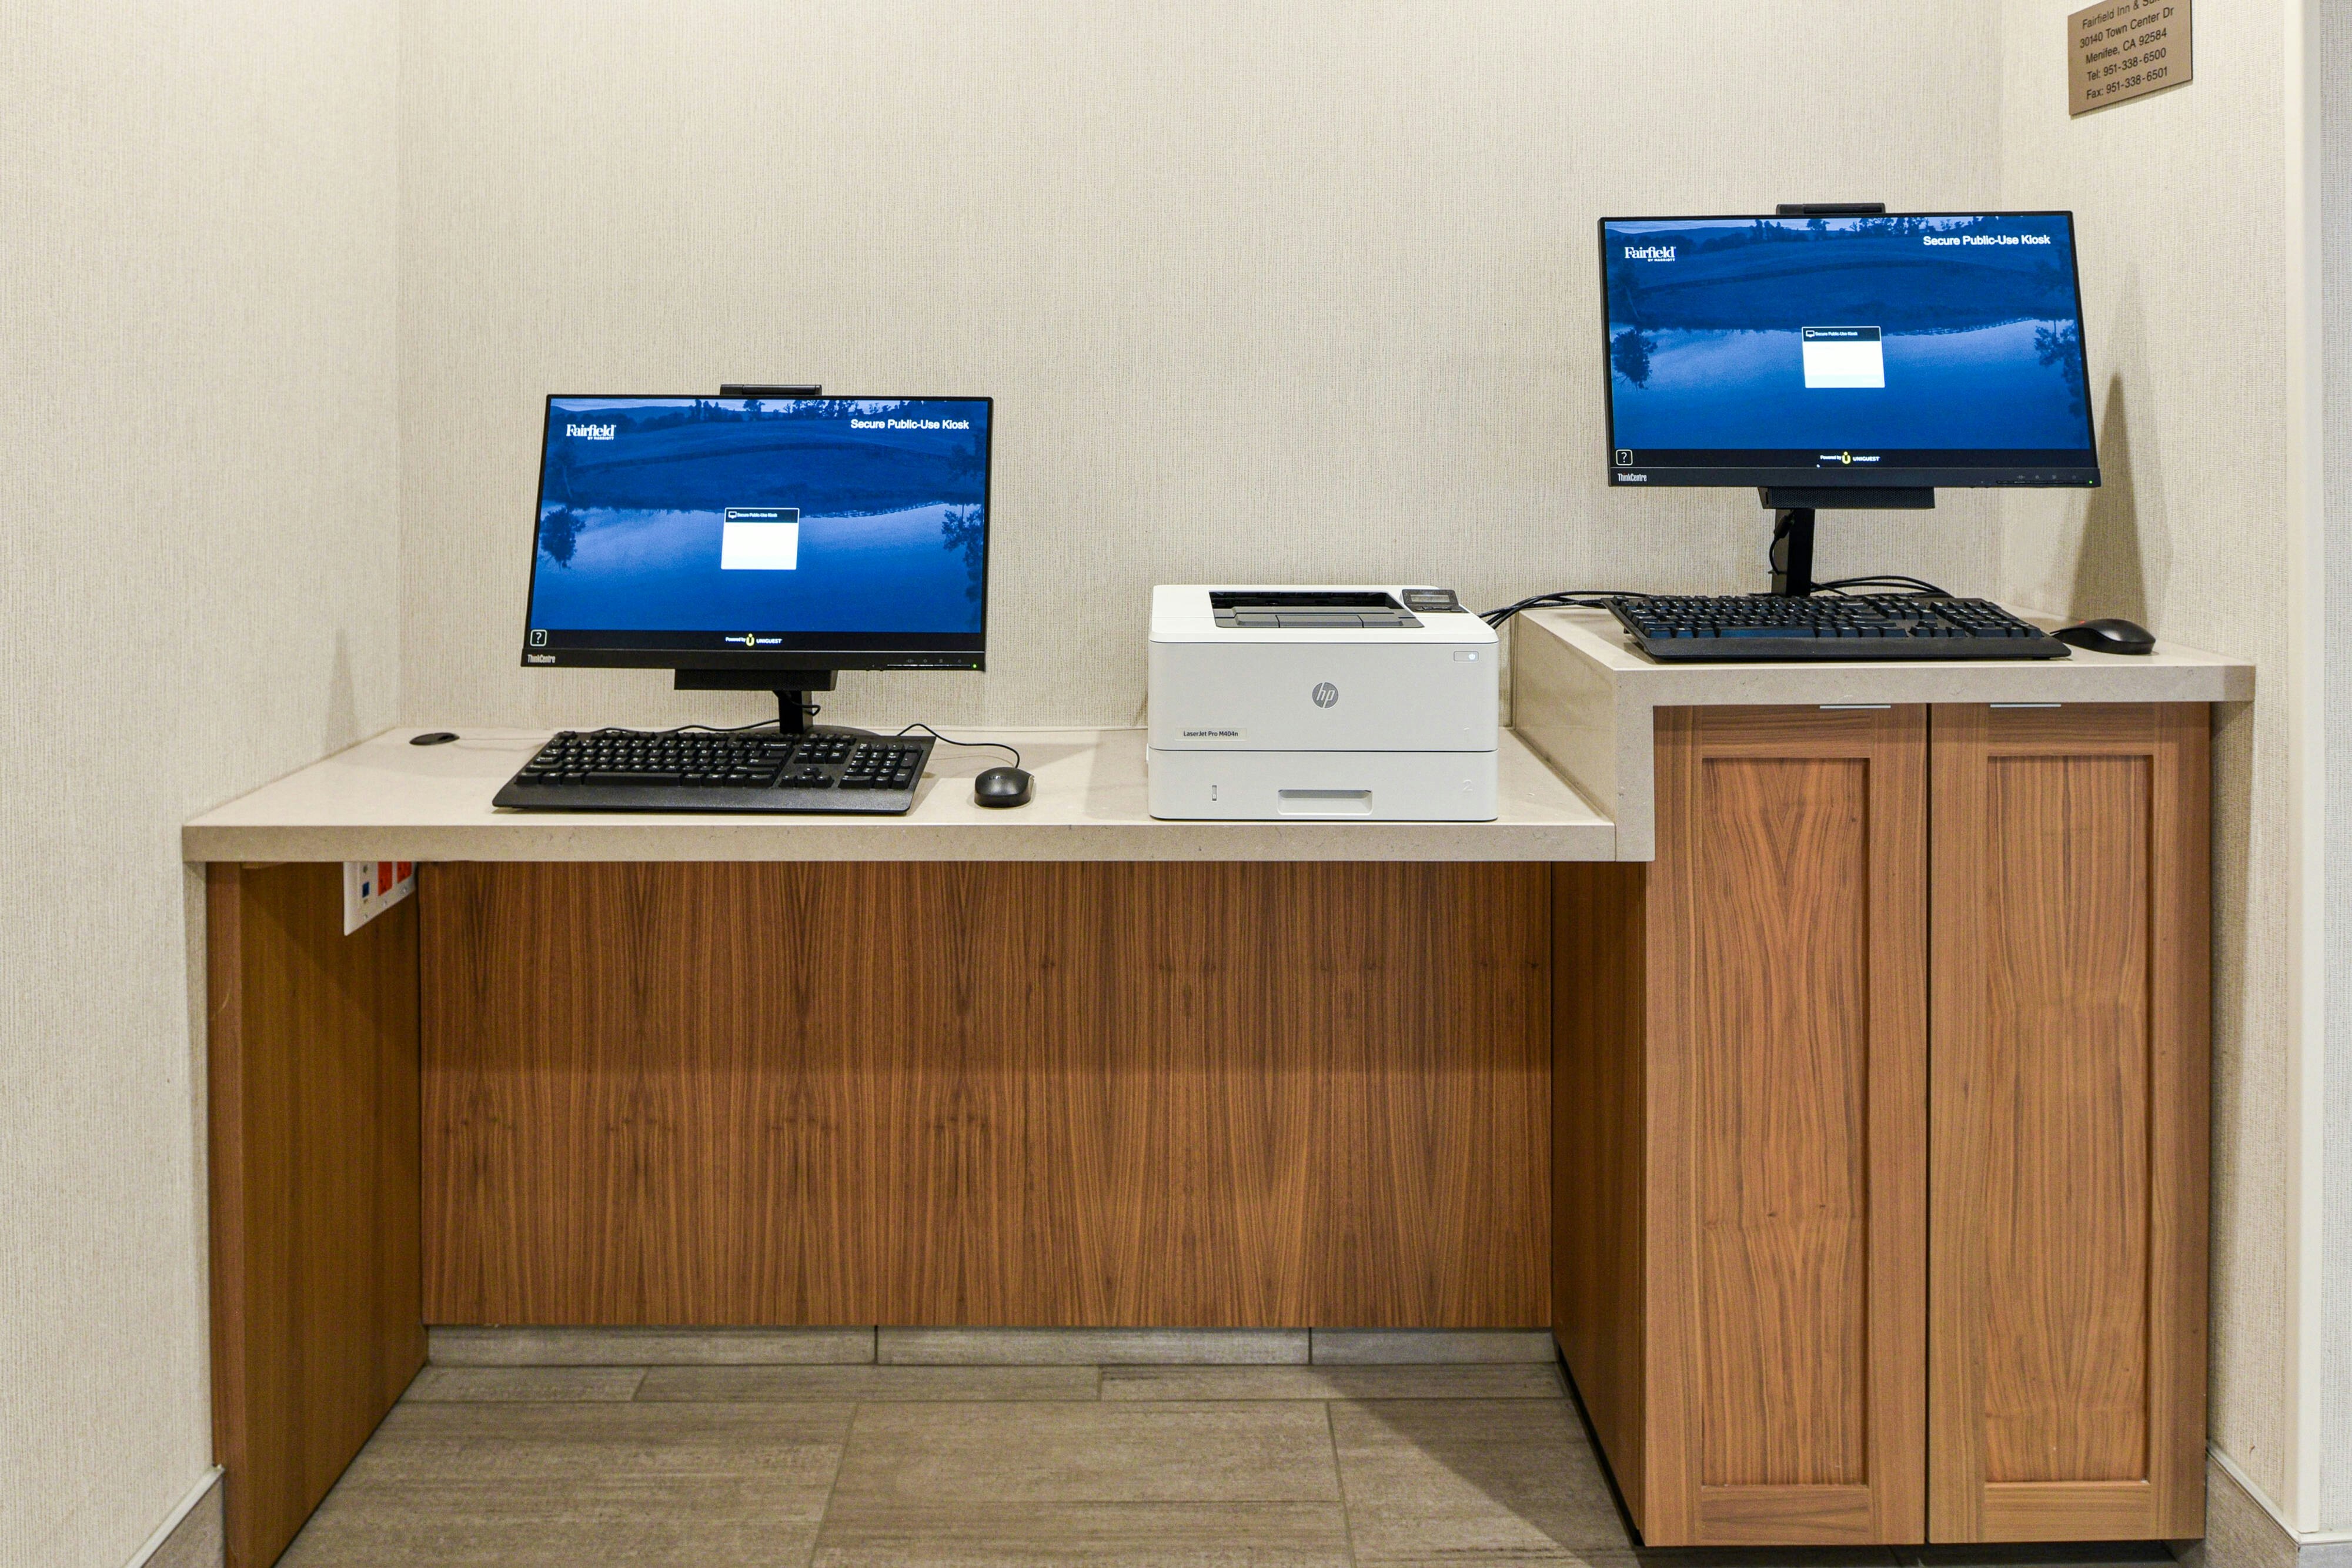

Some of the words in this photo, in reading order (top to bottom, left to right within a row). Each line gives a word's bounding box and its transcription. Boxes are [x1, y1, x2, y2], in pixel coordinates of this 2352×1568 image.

[2082, 8, 2114, 29] Fairfield
[2117, 5, 2130, 16] Inn
[2133, 0, 2139, 10] &
[2080, 31, 2103, 49] 30140
[2106, 24, 2127, 39] Town
[2130, 12, 2160, 29] Center
[2163, 6, 2174, 18] Dr
[2086, 46, 2120, 64] Menifee,
[2123, 38, 2136, 51] CA
[2139, 28, 2167, 46] 92584
[2087, 69, 2100, 81] Tel:
[2103, 47, 2166, 76] 951-338-6500
[2086, 88, 2103, 99] Fax:
[2106, 66, 2167, 94] 951-338-6501
[1923, 236, 1960, 246] Secure
[1962, 235, 2019, 245] Public-Use
[2021, 234, 2051, 245] Kiosk
[1624, 246, 1675, 259] Fairfield
[566, 424, 614, 437] Fairfield
[850, 419, 886, 429] Secure
[887, 419, 940, 430] Public-Use
[942, 419, 969, 430] Kiosk
[1618, 473, 1647, 482] ThinkCentre
[527, 654, 556, 663] ThinkCentre
